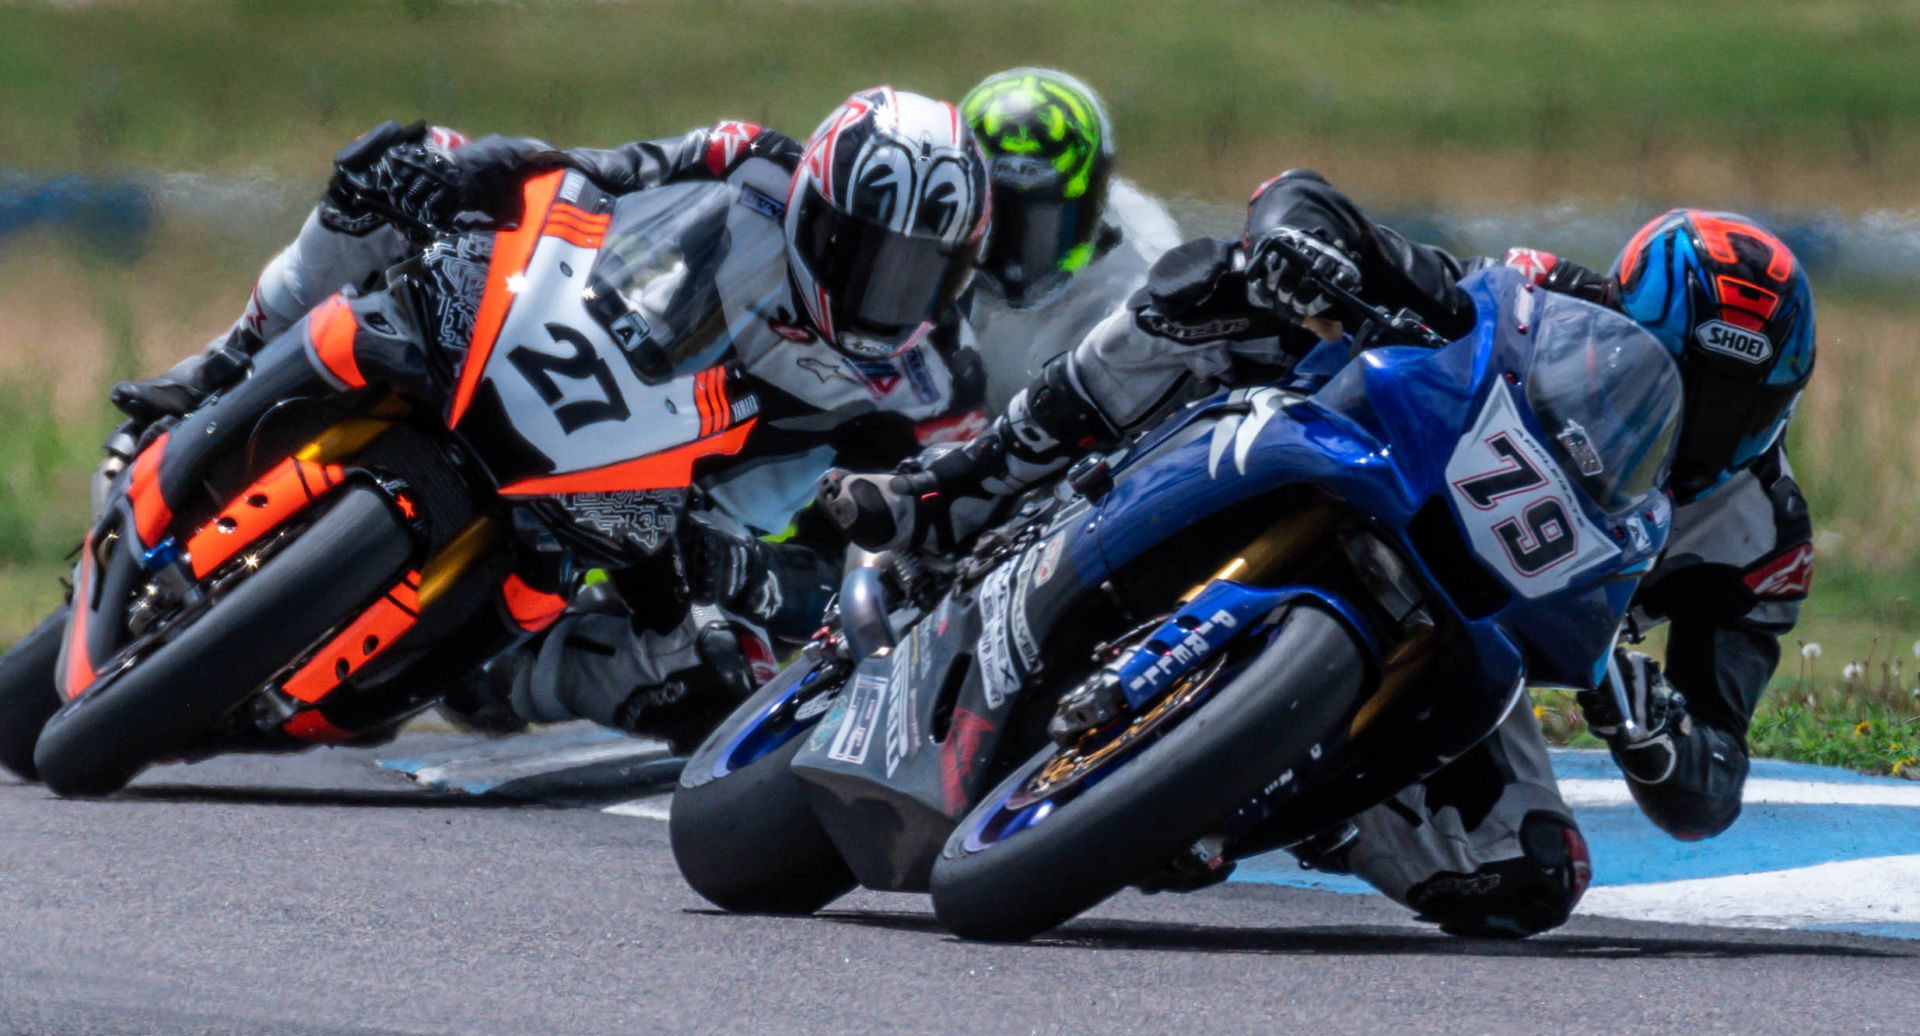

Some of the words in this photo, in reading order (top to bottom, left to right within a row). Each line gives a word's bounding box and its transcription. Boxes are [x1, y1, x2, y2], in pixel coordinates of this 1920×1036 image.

[506, 322, 631, 435] 27
[1708, 326, 1764, 359] SHOEI
[1453, 430, 1579, 576] 79
[1515, 427, 1584, 528] APPLEGATE
[1131, 610, 1237, 690] PIRELLI
